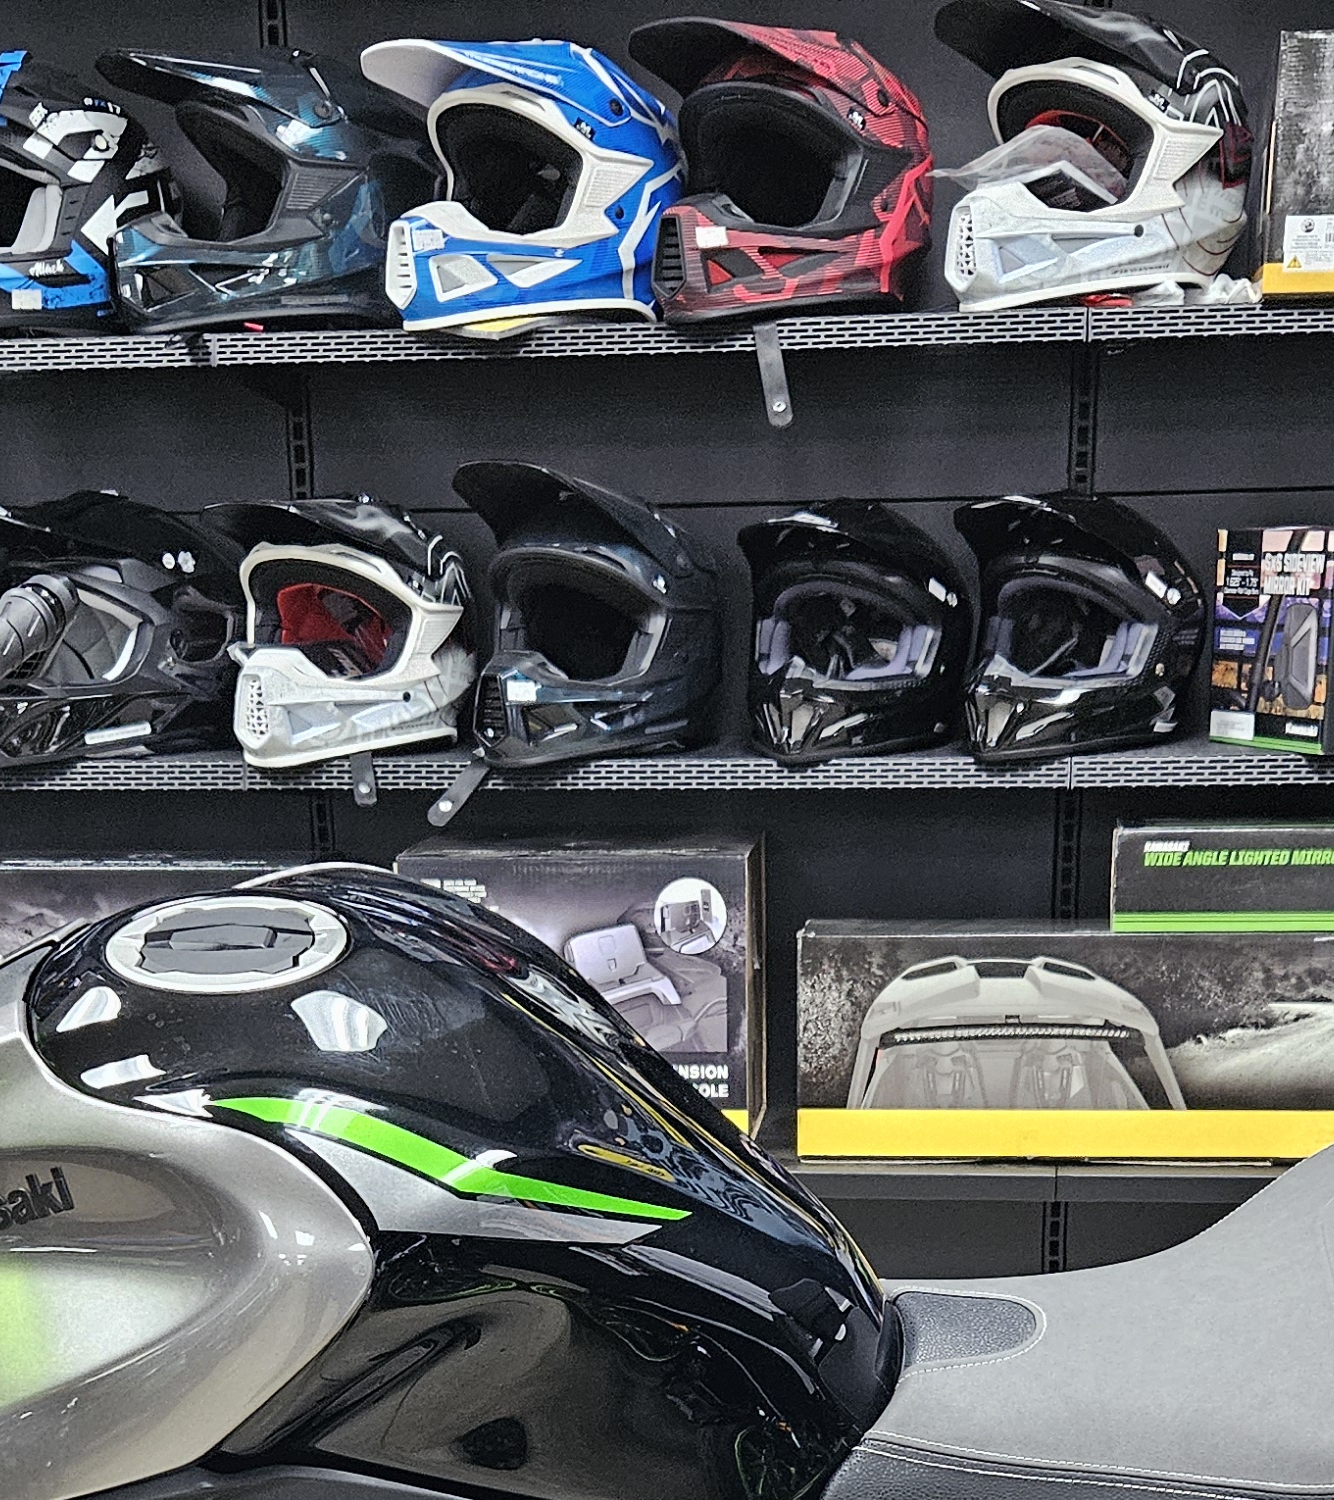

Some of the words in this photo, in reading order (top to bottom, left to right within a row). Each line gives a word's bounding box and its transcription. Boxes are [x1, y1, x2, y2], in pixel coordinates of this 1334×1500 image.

[1284, 553, 1326, 574] SIDEVIEW
[1263, 575, 1295, 595] MIRROR
[1296, 576, 1311, 596] KIT
[1144, 852, 1183, 866] WIDE
[1183, 851, 1229, 866] ANGLE
[1229, 851, 1290, 865] LIGHTED
[693, 1083, 729, 1098] OLE
